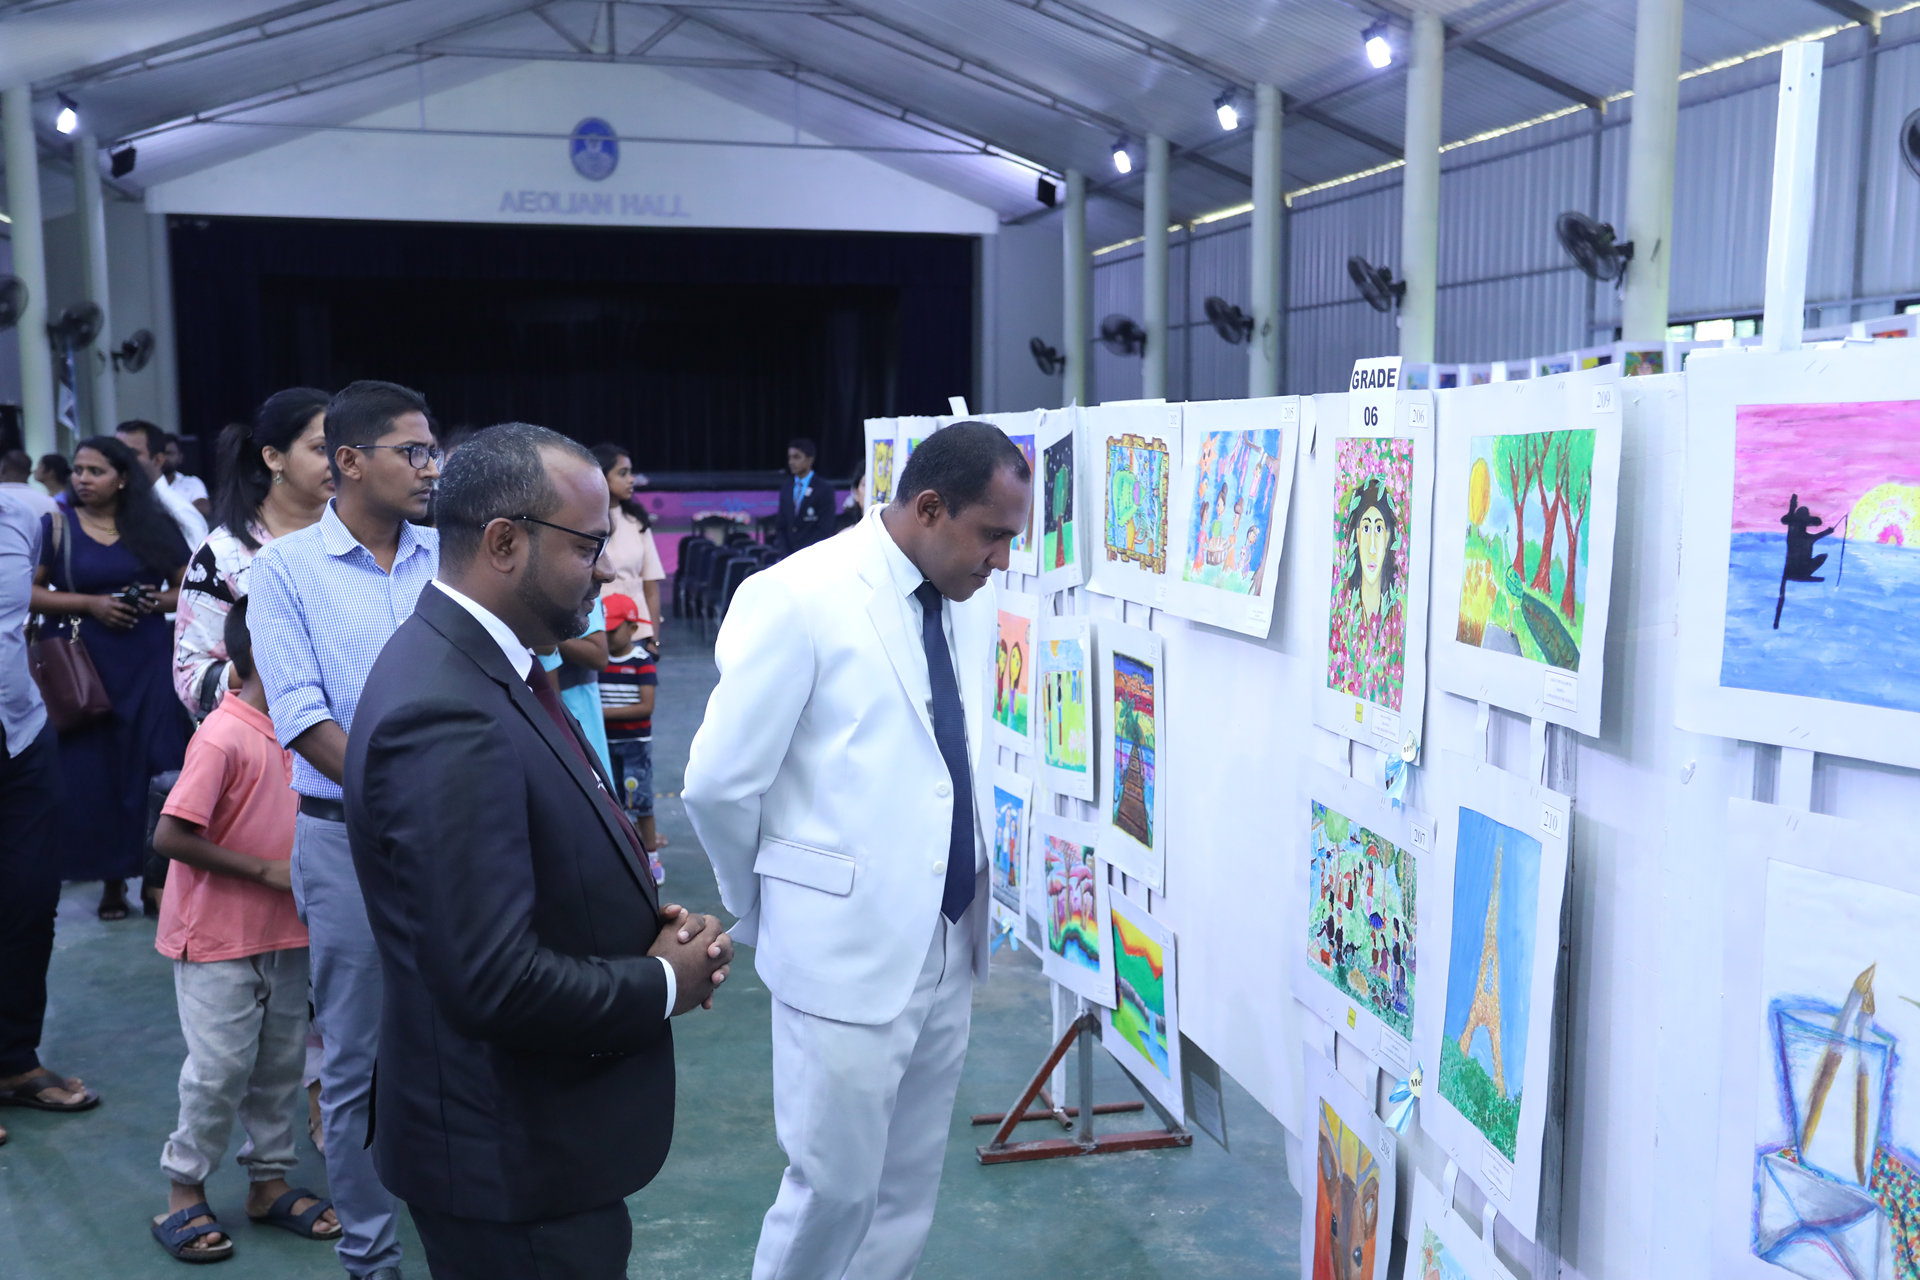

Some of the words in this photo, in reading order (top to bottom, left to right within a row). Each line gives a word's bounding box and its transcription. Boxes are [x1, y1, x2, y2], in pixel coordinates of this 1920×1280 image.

[499, 190, 613, 215] AEOLIAN
[620, 193, 692, 218] HALL
[1352, 368, 1397, 390] GRADE
[1596, 390, 1611, 408] 209
[1364, 406, 1379, 426] 06
[1412, 409, 1425, 423] 206
[1543, 811, 1558, 831] 210
[1414, 828, 1426, 846] 207
